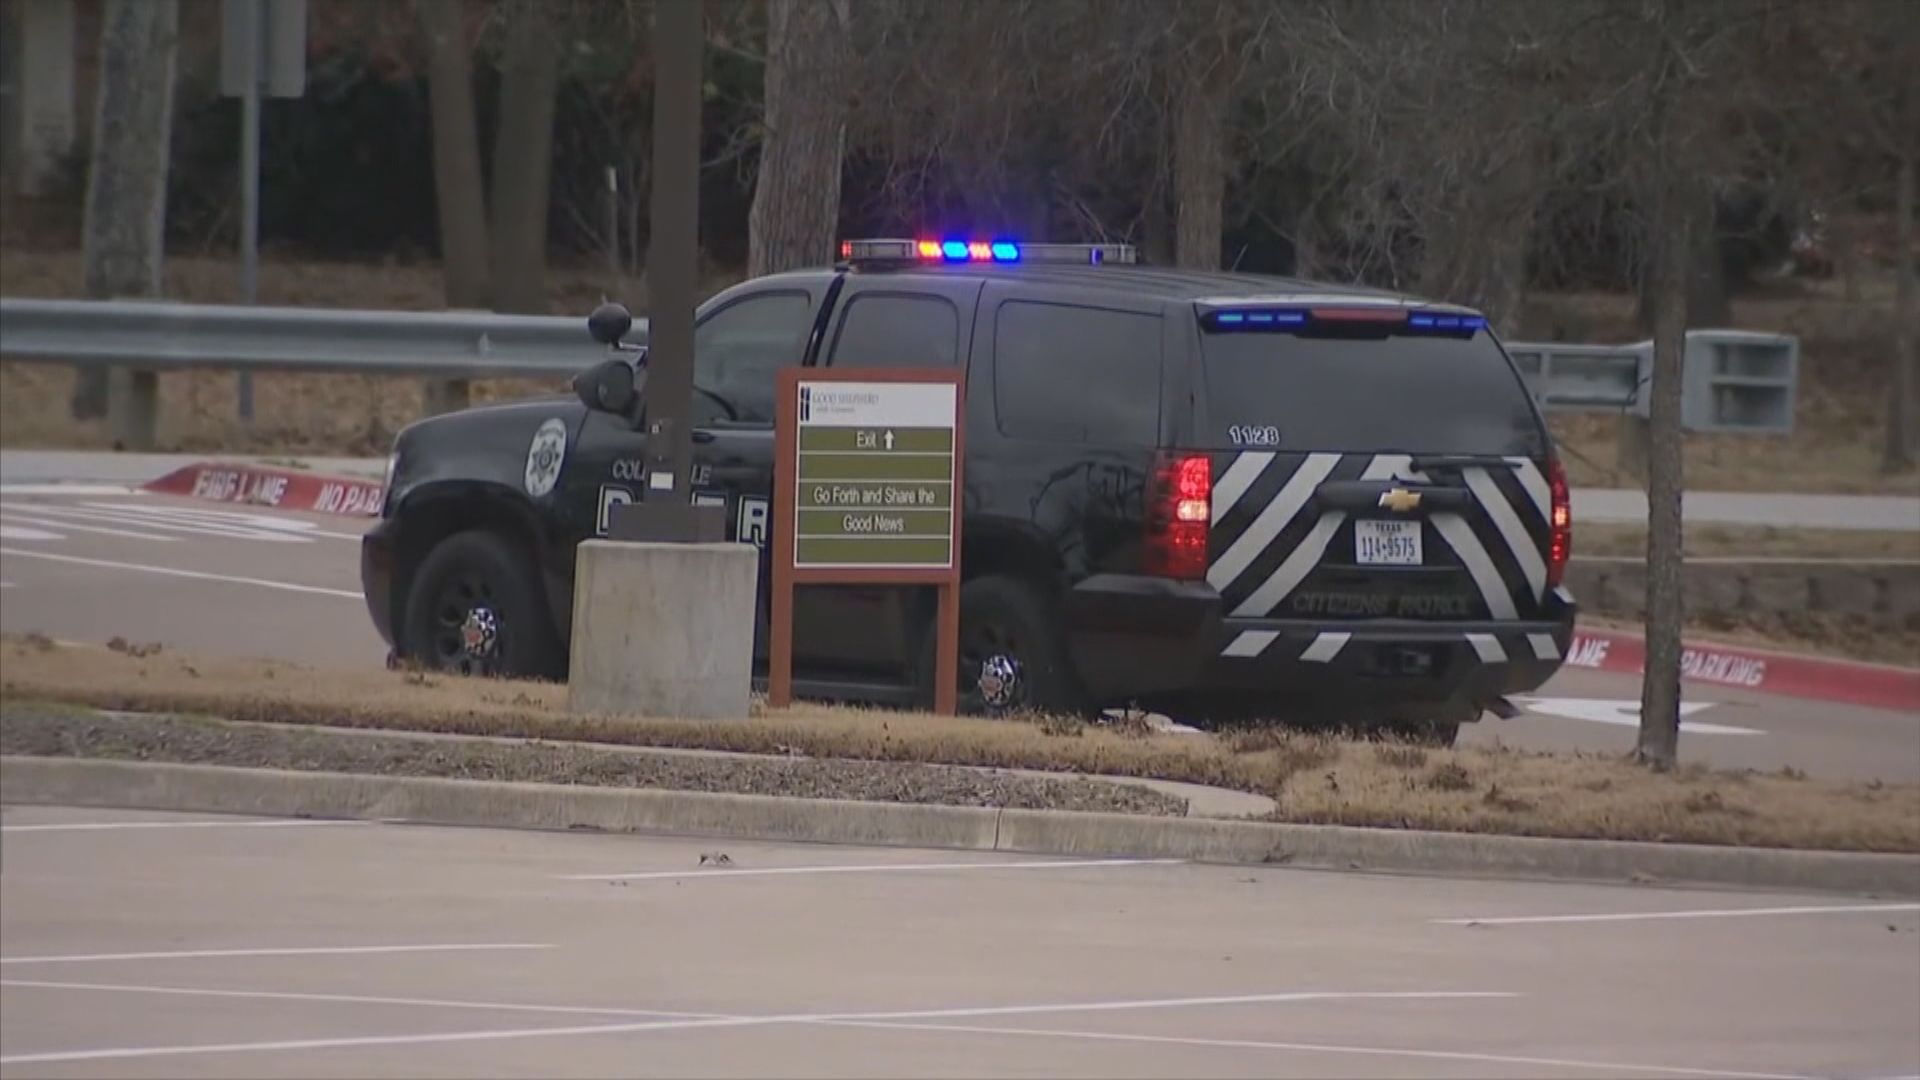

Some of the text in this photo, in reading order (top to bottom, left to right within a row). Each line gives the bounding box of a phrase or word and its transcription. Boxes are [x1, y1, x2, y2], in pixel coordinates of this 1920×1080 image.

[856, 430, 876, 448] Exit
[1228, 425, 1280, 445] 1128
[235, 471, 288, 505] LANE
[314, 482, 385, 513] NO PAR
[813, 486, 935, 504] Go Forth and Share the
[843, 514, 904, 531] Good News
[1375, 521, 1402, 533] TEXAS
[1565, 637, 1610, 667] ANE
[1680, 650, 1766, 686] PARKING
